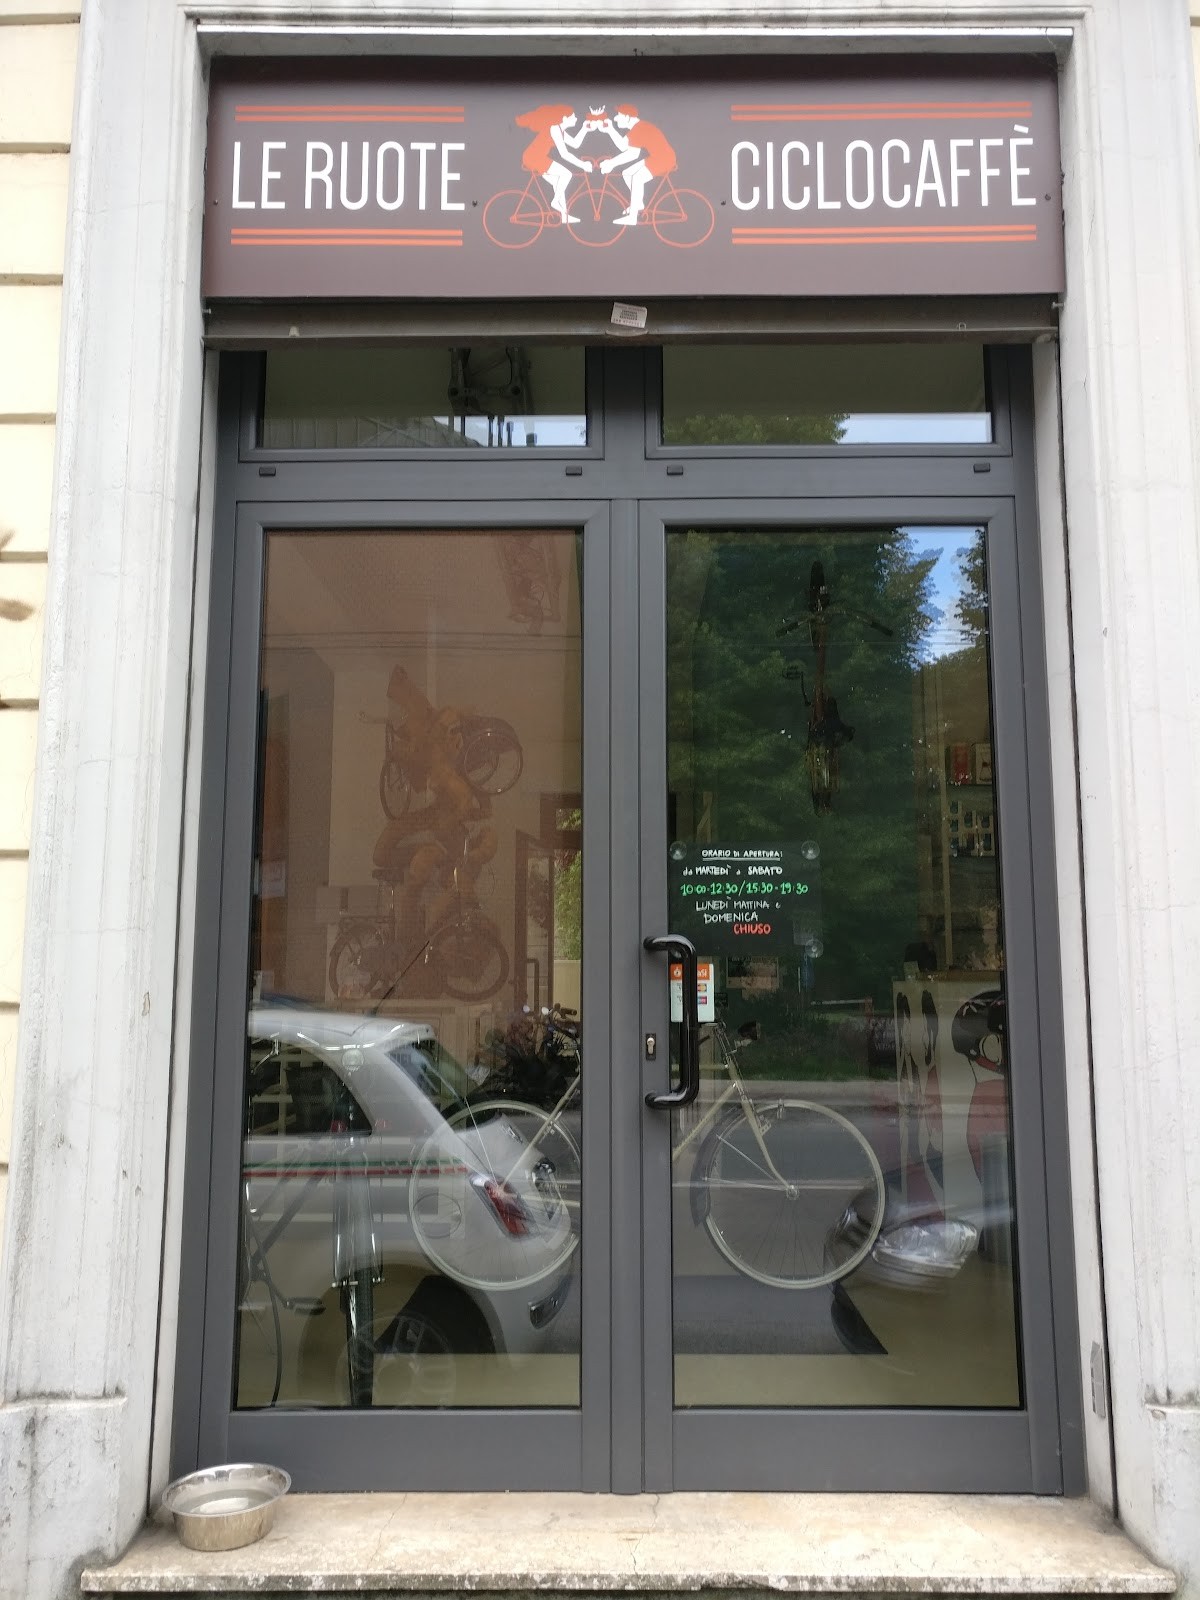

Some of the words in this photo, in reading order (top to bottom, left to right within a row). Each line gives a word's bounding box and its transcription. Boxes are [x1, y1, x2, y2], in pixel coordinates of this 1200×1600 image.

[731, 124, 1037, 210] CICLOCAFFÈ
[231, 141, 286, 210] LE
[304, 141, 465, 211] RUOTE
[701, 849, 731, 858] ORARIO
[733, 850, 740, 858] DI
[682, 866, 693, 876] da
[747, 866, 783, 876] SABATO
[703, 911, 759, 924] DOMENICA
[733, 923, 771, 935] CHIUSO
